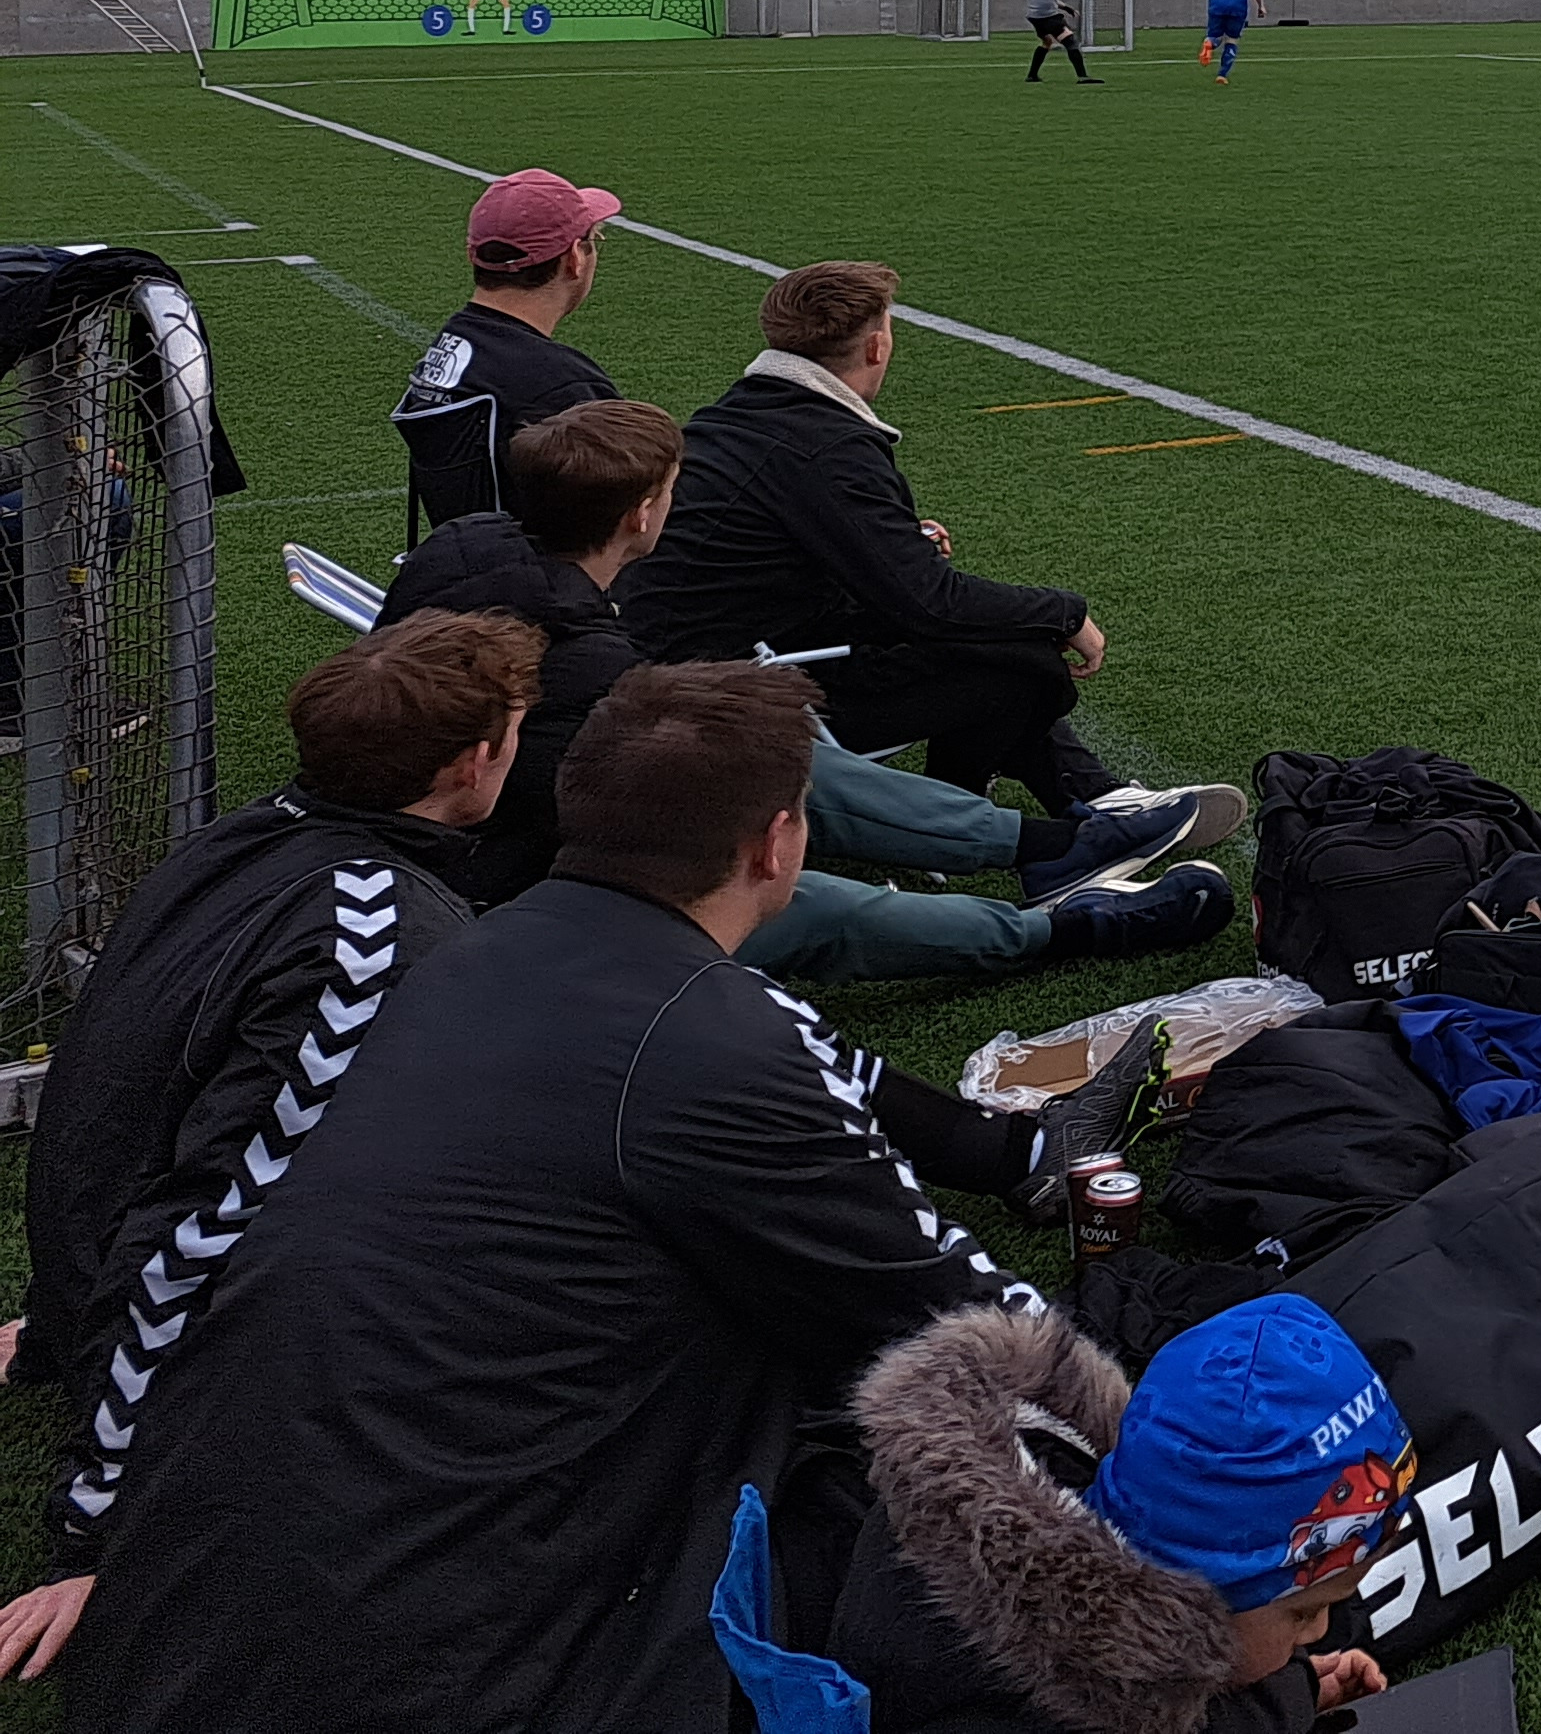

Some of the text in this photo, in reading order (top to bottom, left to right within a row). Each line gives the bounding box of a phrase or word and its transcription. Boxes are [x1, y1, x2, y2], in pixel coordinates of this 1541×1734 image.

[431, 11, 444, 30] 5
[531, 10, 544, 29] 5
[436, 332, 462, 353] THE
[1080, 1224, 1121, 1242] ROYAL
[1309, 1382, 1378, 1460] PAW
